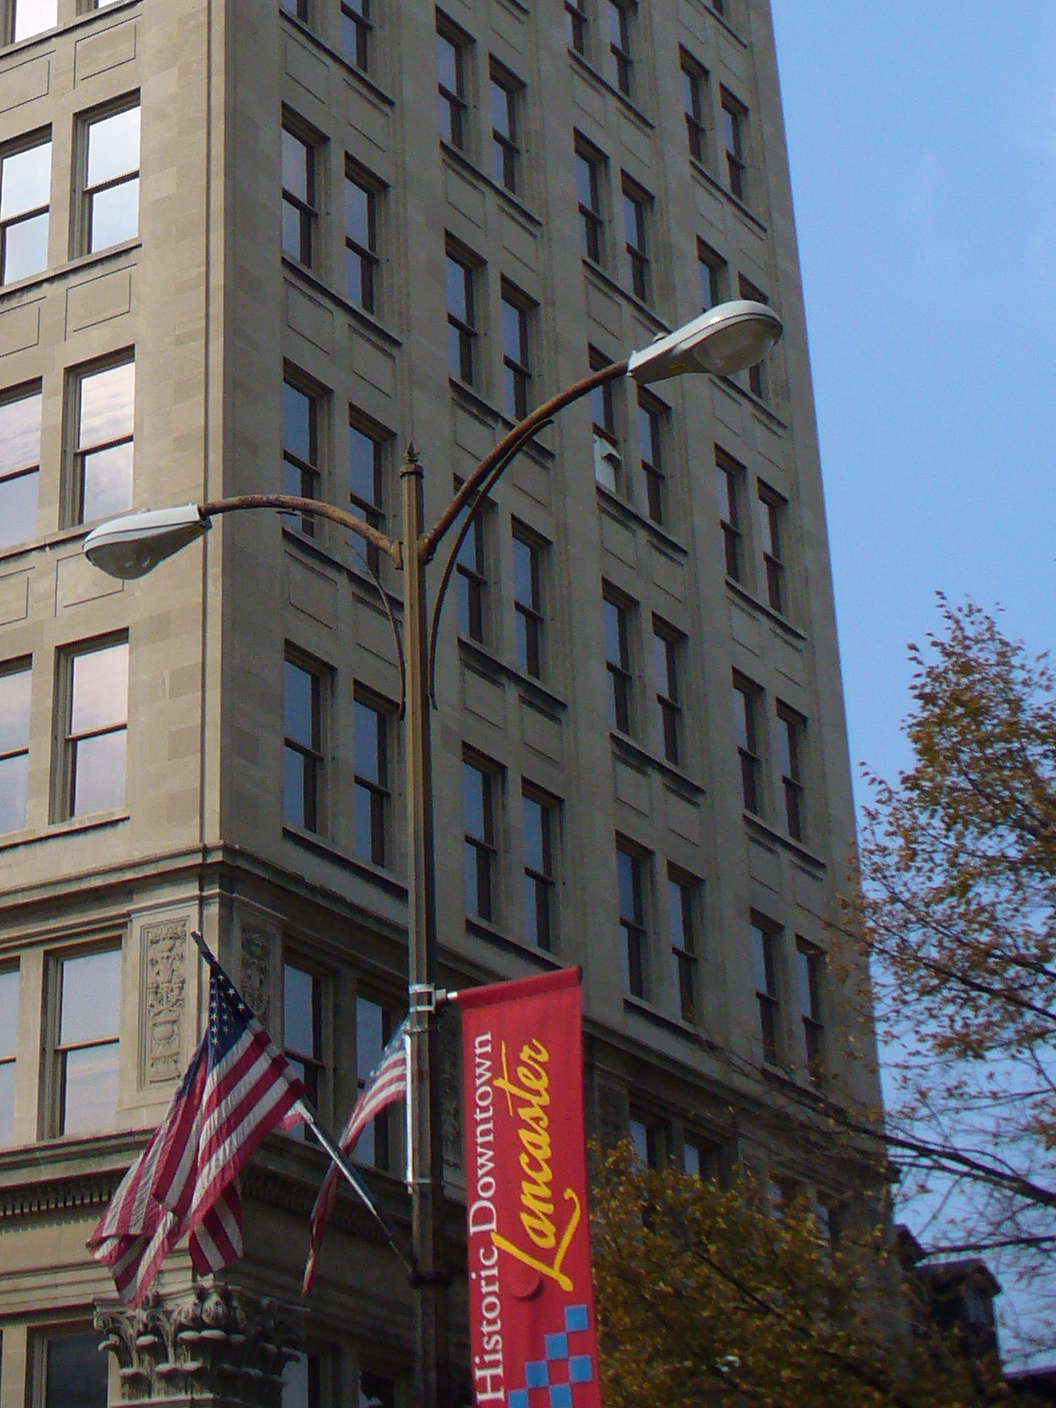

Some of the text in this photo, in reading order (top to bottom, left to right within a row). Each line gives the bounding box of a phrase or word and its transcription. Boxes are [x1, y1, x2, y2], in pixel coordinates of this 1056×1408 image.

[469, 1031, 505, 1405] Historic Downtown
[491, 1038, 581, 1291] Lancaster
